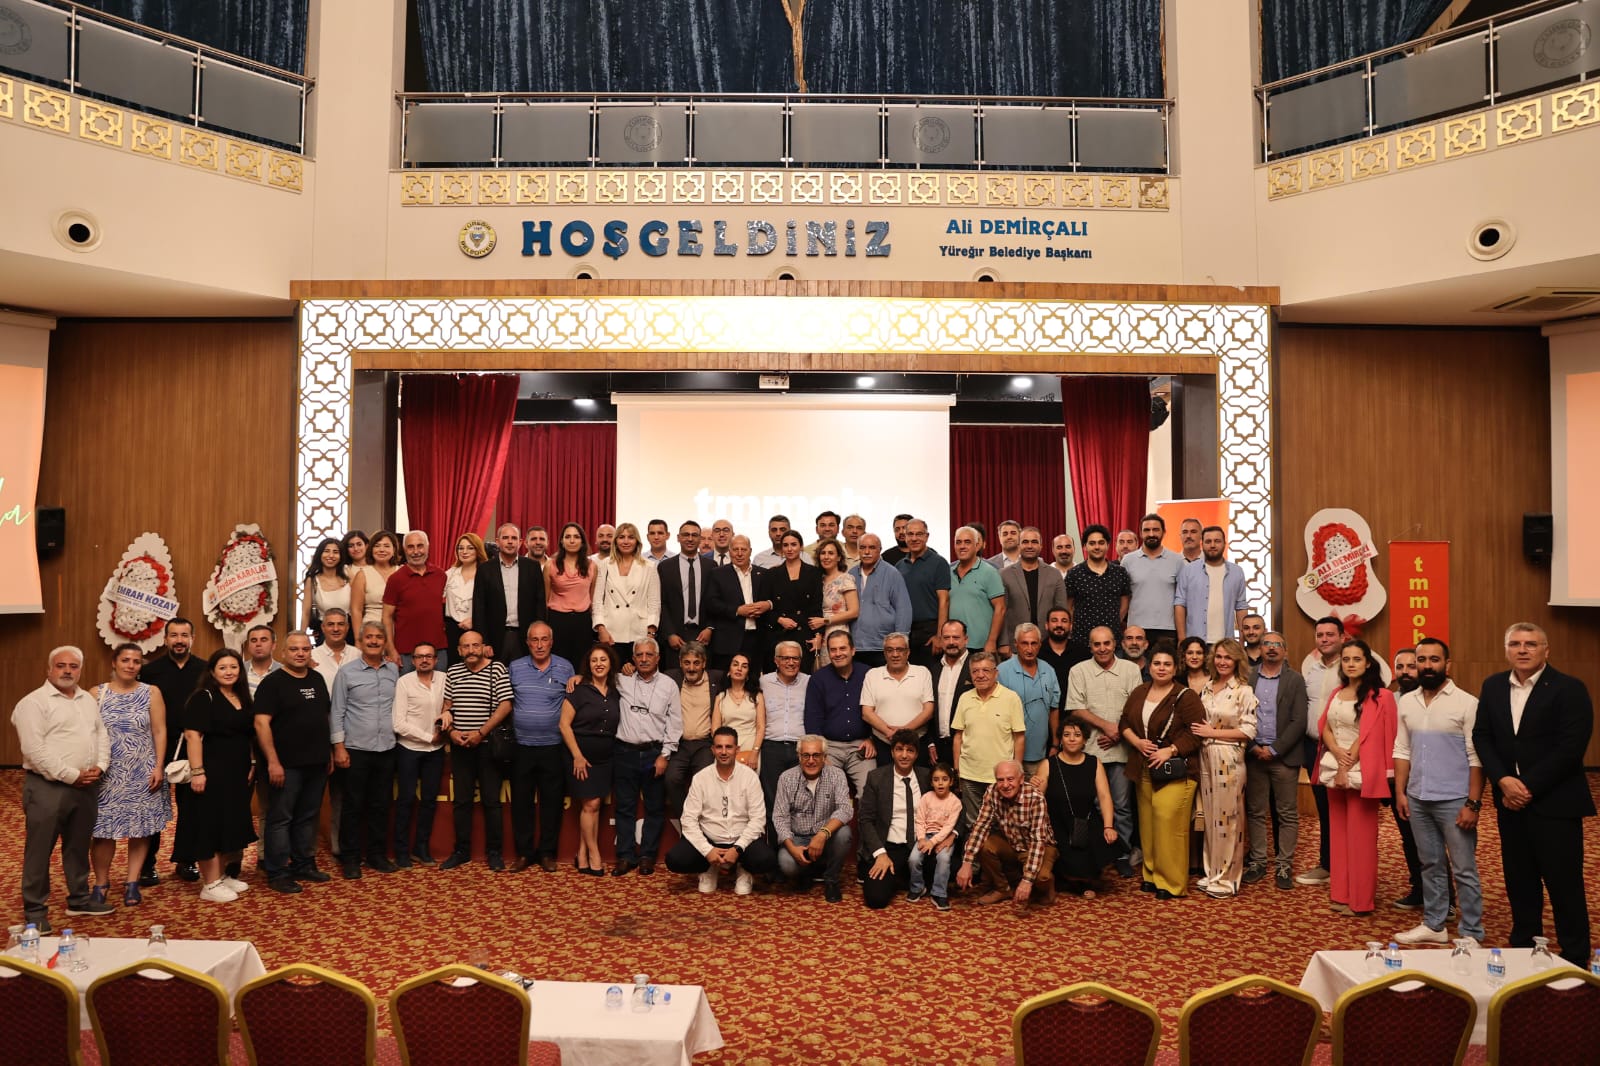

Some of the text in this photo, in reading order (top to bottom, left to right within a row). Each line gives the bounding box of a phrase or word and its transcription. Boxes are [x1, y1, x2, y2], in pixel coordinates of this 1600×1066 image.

[946, 217, 1088, 241] Ali DEMİRÇALI
[989, 246, 1041, 260] Belediye
[1045, 247, 1093, 261] Başkanı
[144, 594, 177, 611] KOZAY
[1409, 556, 1429, 645] tmmob
